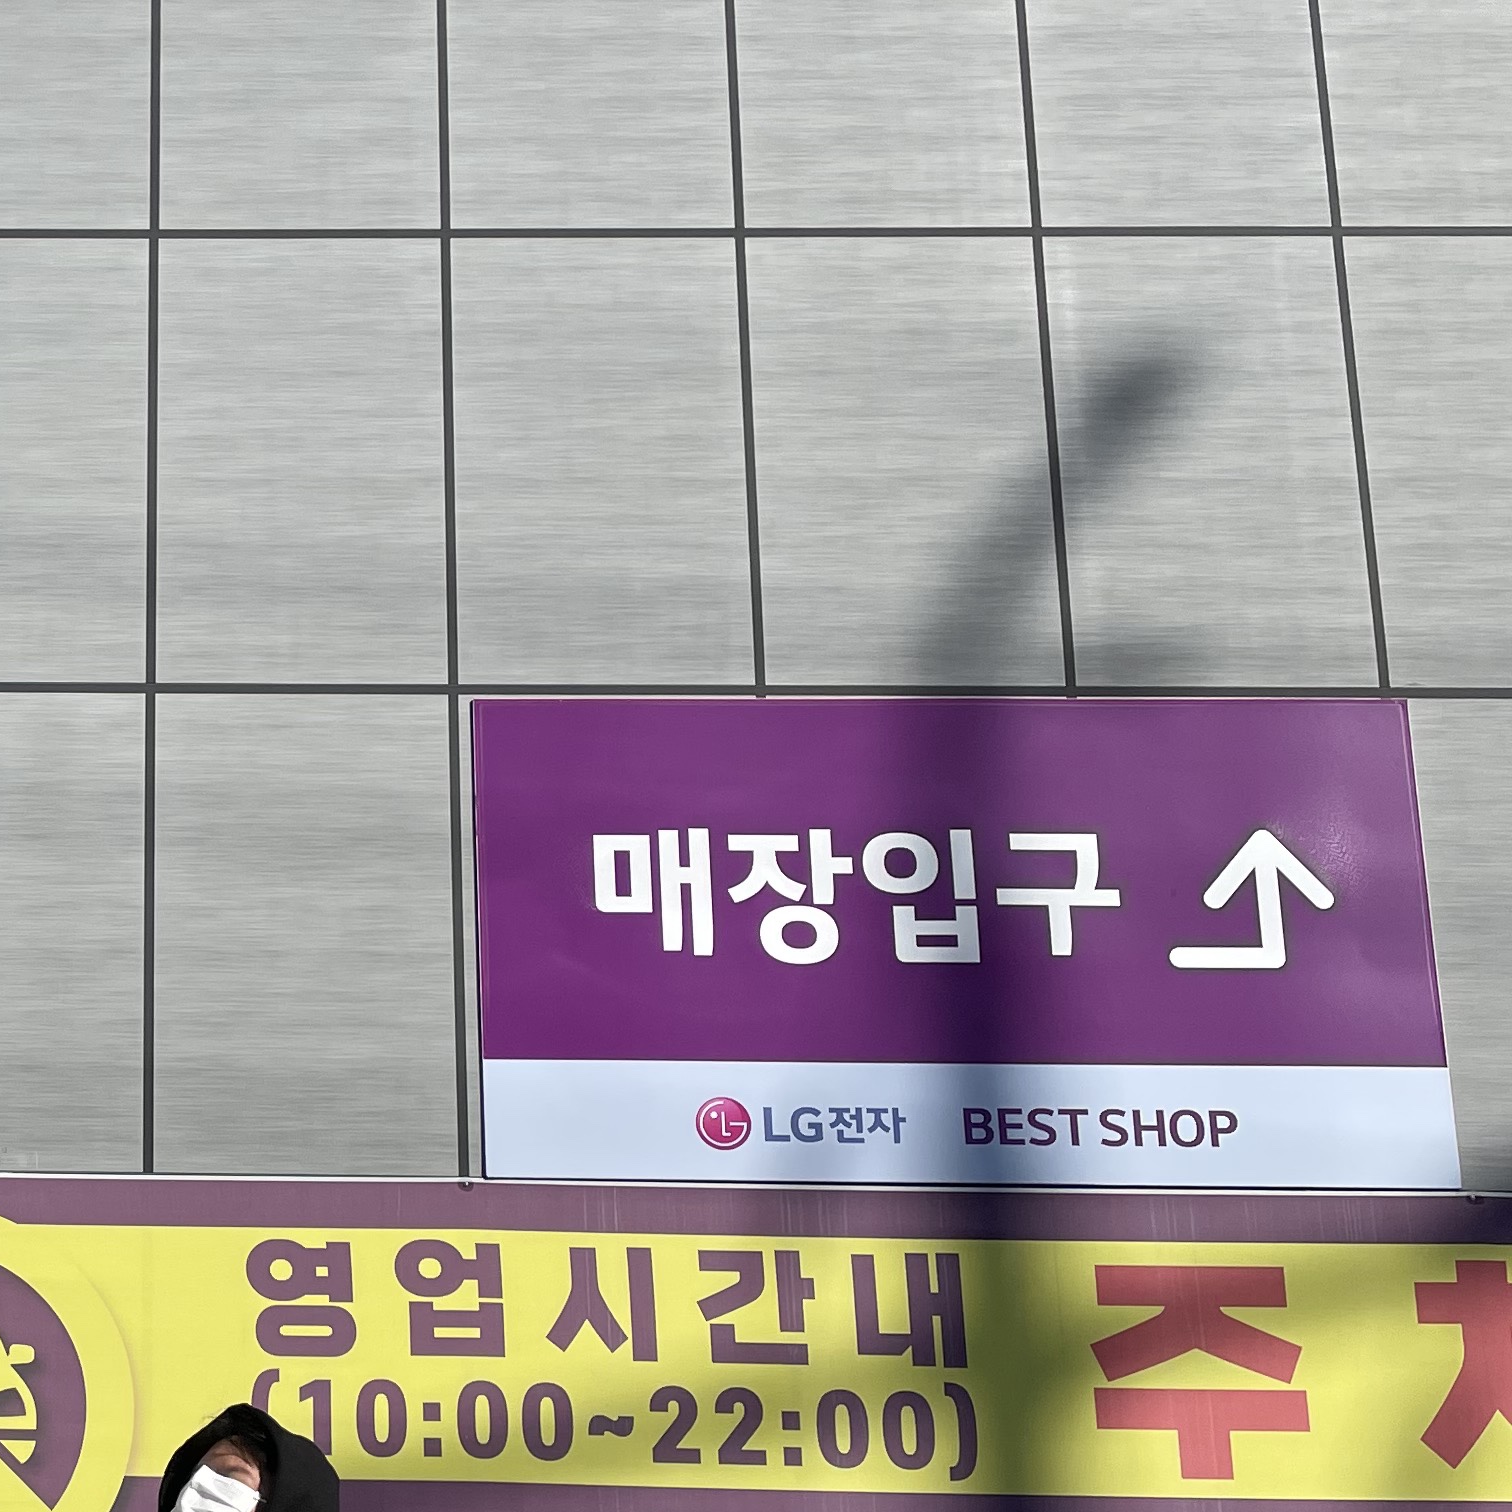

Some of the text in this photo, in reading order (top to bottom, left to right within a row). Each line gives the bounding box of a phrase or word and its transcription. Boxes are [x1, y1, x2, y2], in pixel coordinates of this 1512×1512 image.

[592, 827, 1121, 965] 매장입구
[762, 1105, 907, 1145] LG전자
[963, 1106, 1089, 1147] BEST
[1098, 1108, 1238, 1148] SHOP
[245, 1239, 969, 1368] 영업시간내
